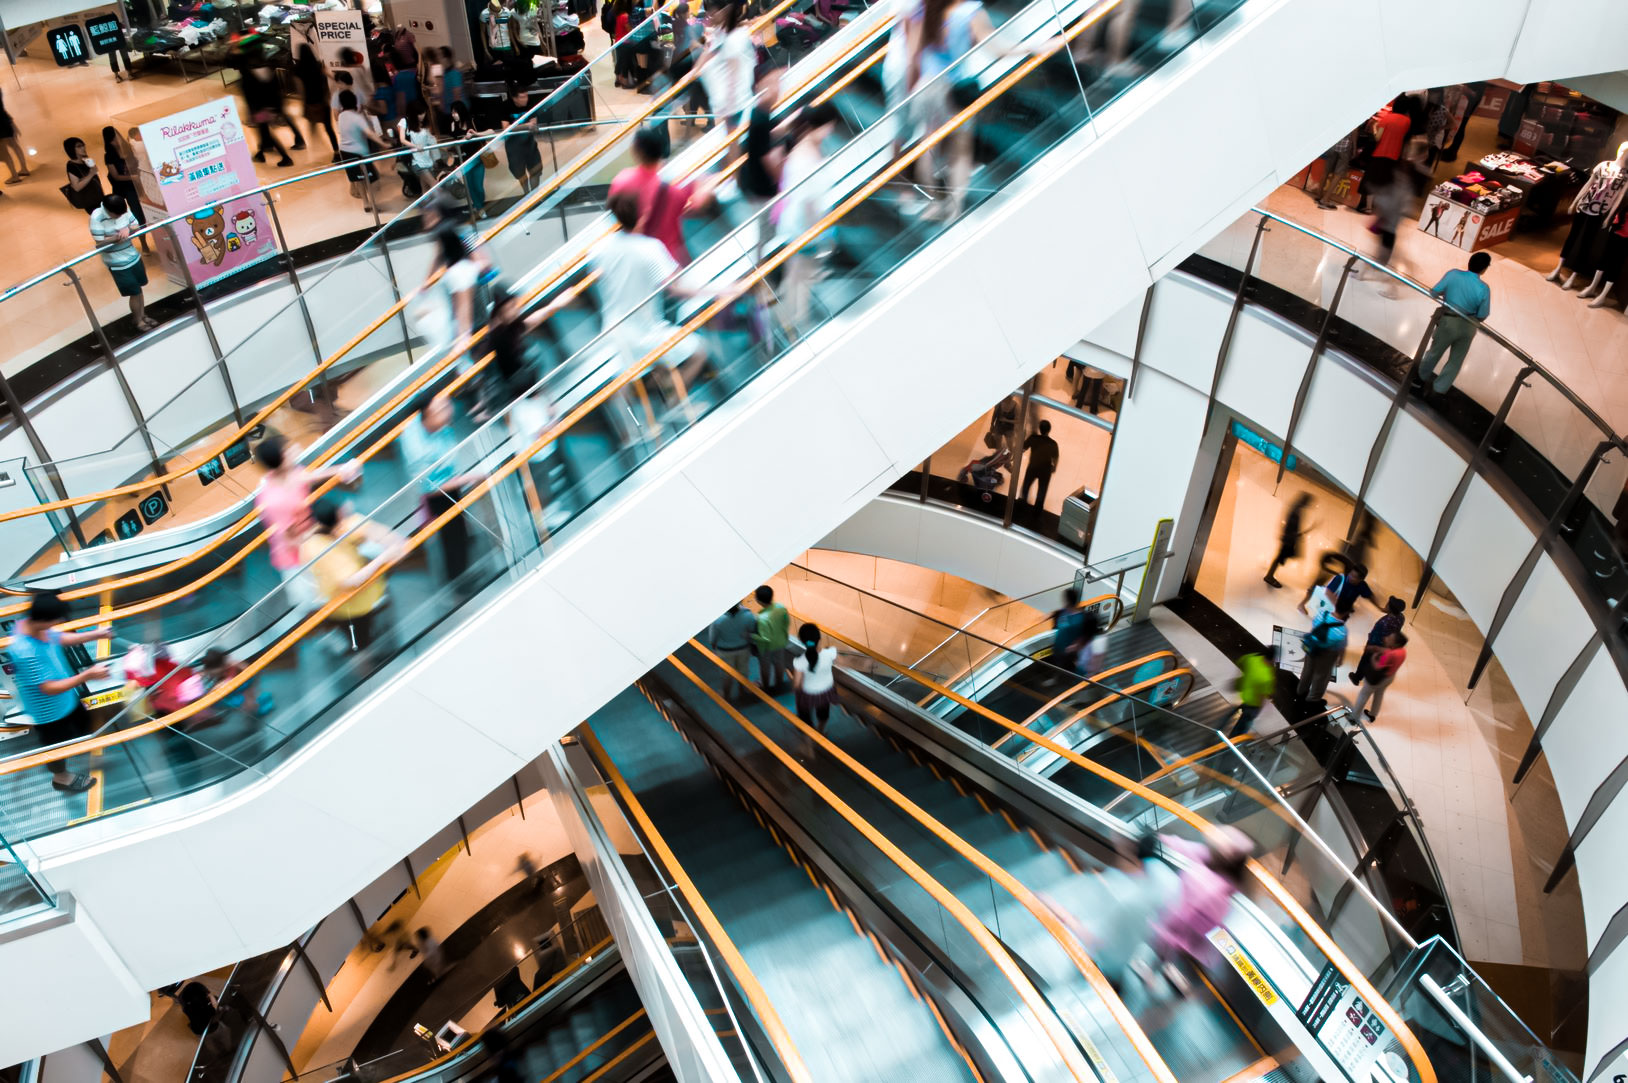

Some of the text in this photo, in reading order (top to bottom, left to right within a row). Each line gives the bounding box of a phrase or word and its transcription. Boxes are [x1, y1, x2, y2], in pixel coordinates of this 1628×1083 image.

[318, 21, 361, 31] SPECIAL
[320, 30, 351, 39] PRICE
[1478, 98, 1503, 111] LE
[160, 116, 216, 140] Rilakkuma
[1479, 217, 1515, 241] SALE
